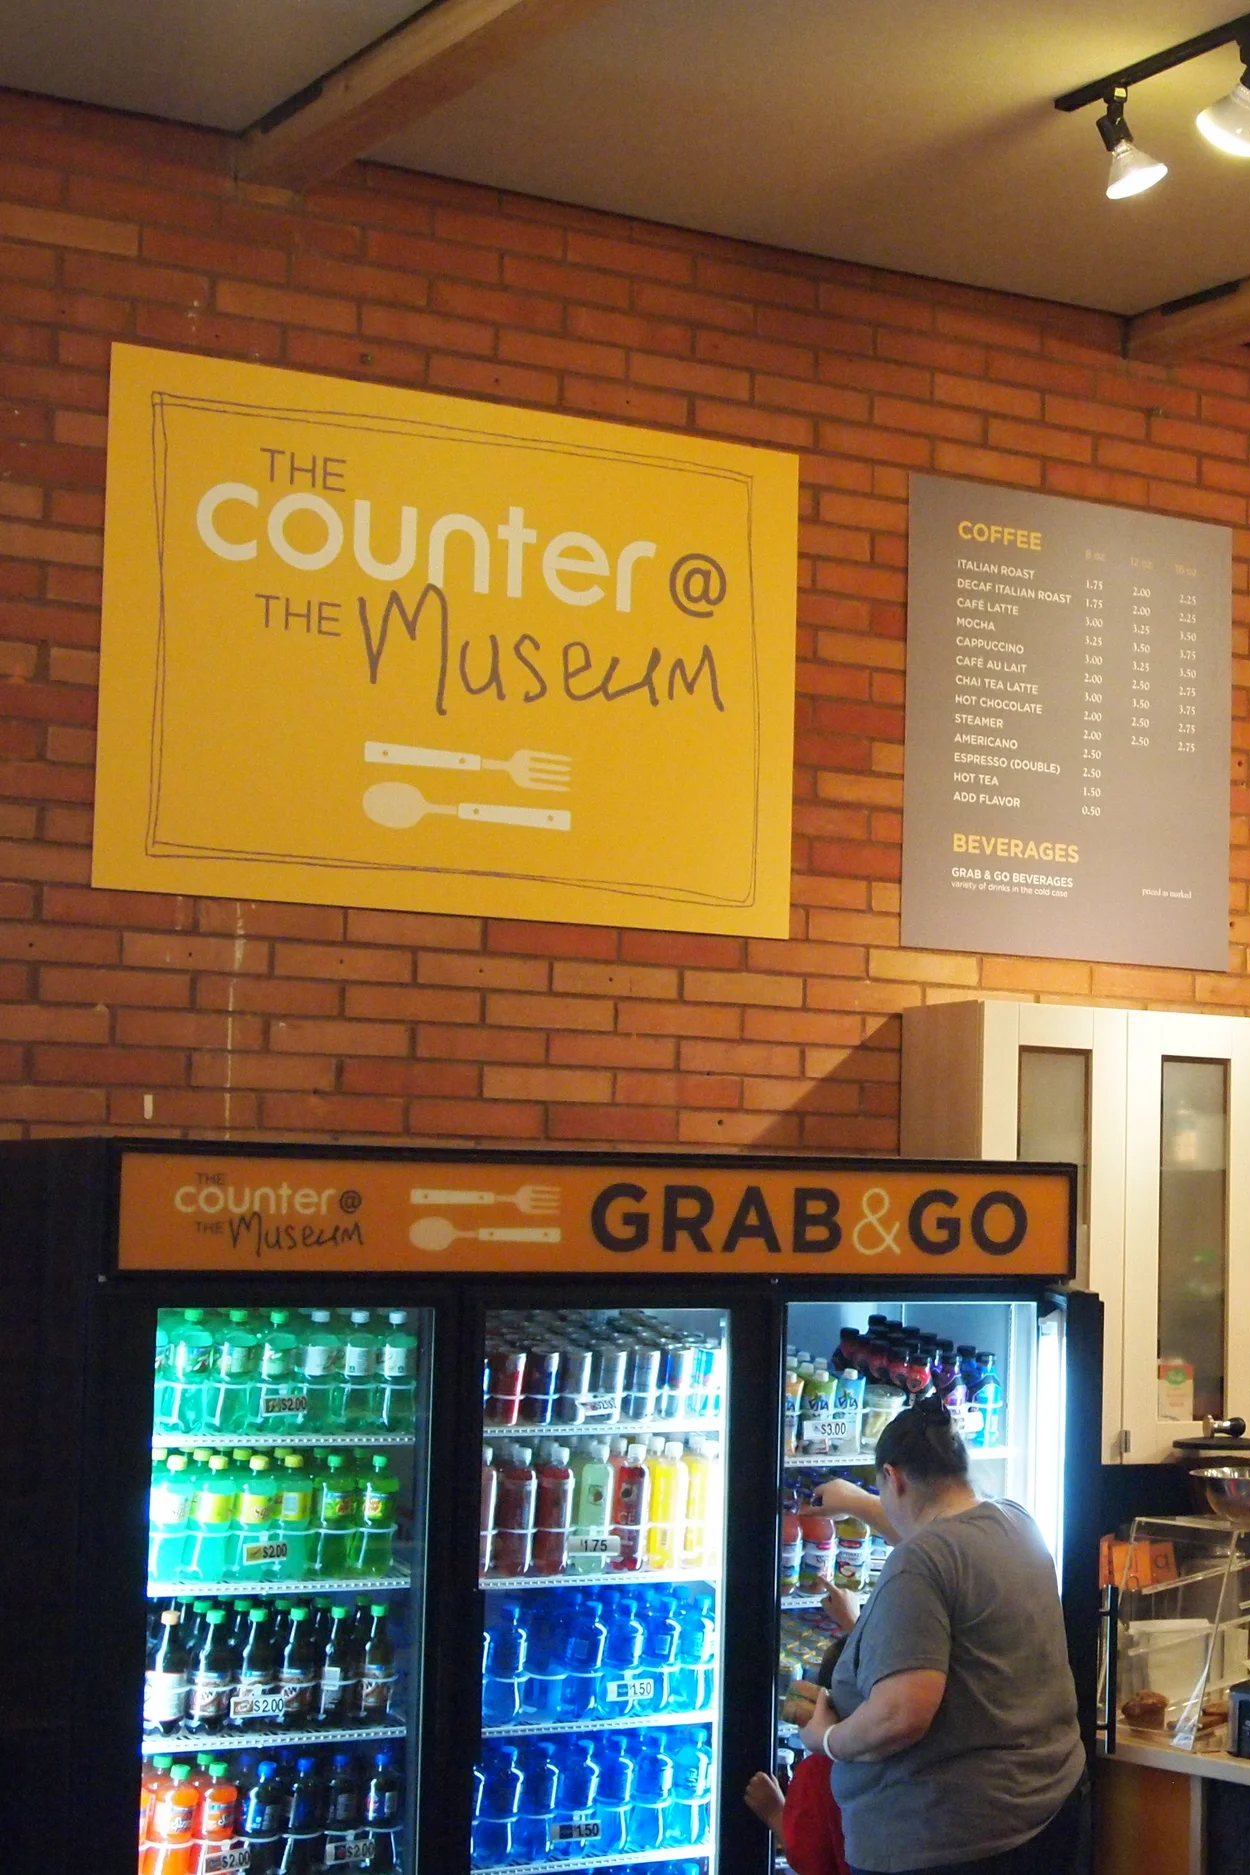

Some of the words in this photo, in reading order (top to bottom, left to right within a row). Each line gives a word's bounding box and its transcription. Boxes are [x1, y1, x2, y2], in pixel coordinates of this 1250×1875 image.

[260, 447, 346, 492] THE
[957, 520, 1042, 551] COFFEE
[196, 482, 656, 613] counter
[668, 552, 727, 617] @
[957, 558, 998, 574] ITALIAN
[1000, 565, 1035, 579] ROAST
[957, 577, 993, 592] DECAF
[995, 583, 1035, 599] ITALIAN
[1037, 590, 1071, 604] ROAST
[1086, 579, 1103, 590] 1.75
[956, 597, 984, 610] CAFÉ
[987, 602, 1019, 615] LATTE
[1086, 598, 1103, 609] 1.75
[956, 616, 995, 631] MOCHA
[1085, 616, 1103, 628] 3.00
[255, 593, 342, 637] THE
[358, 582, 724, 716] Museum
[955, 635, 1024, 654] CAPPUCCINO
[1085, 635, 1102, 646] 3.25
[955, 655, 983, 668] CAFÉ
[986, 659, 1001, 671] AU
[1003, 661, 1027, 673] LAIT
[1084, 653, 1103, 665] 3.00
[955, 674, 981, 687] CHAI
[983, 678, 1004, 690] TEA
[1006, 681, 1038, 695] LATTE
[955, 694, 977, 705] HOT
[979, 697, 1042, 714] CHOCOLATE
[954, 713, 1003, 728] STEAMER
[954, 732, 1018, 750] AMERICANO
[1082, 748, 1102, 759] 2.50
[953, 751, 1008, 767] ESPRESSO
[1009, 758, 1060, 775] (DOUBLE)
[953, 771, 976, 783] HOT
[978, 774, 999, 786] TEA
[1082, 767, 1101, 778] 2.50
[953, 791, 977, 803] ADD
[979, 793, 1020, 807] FLAVOR
[1083, 786, 1101, 797] 1.50
[1081, 805, 1101, 816] 0.50
[953, 832, 1079, 863] BEVERAGES
[951, 867, 982, 879] GRAB
[983, 869, 991, 880] &
[993, 870, 1010, 882] GO
[1012, 872, 1073, 888] BEVERAGES
[194, 1172, 225, 1186] THE
[174, 1181, 336, 1216] counter
[339, 1190, 362, 1215] @
[195, 1220, 224, 1234] THE
[229, 1211, 364, 1257] Museum
[281, 1395, 307, 1411] $2.00
[821, 1422, 847, 1436] $3.00
[262, 1543, 288, 1558] $2.00
[253, 1699, 284, 1713] $2.00
[222, 1850, 250, 1868] $2.00
